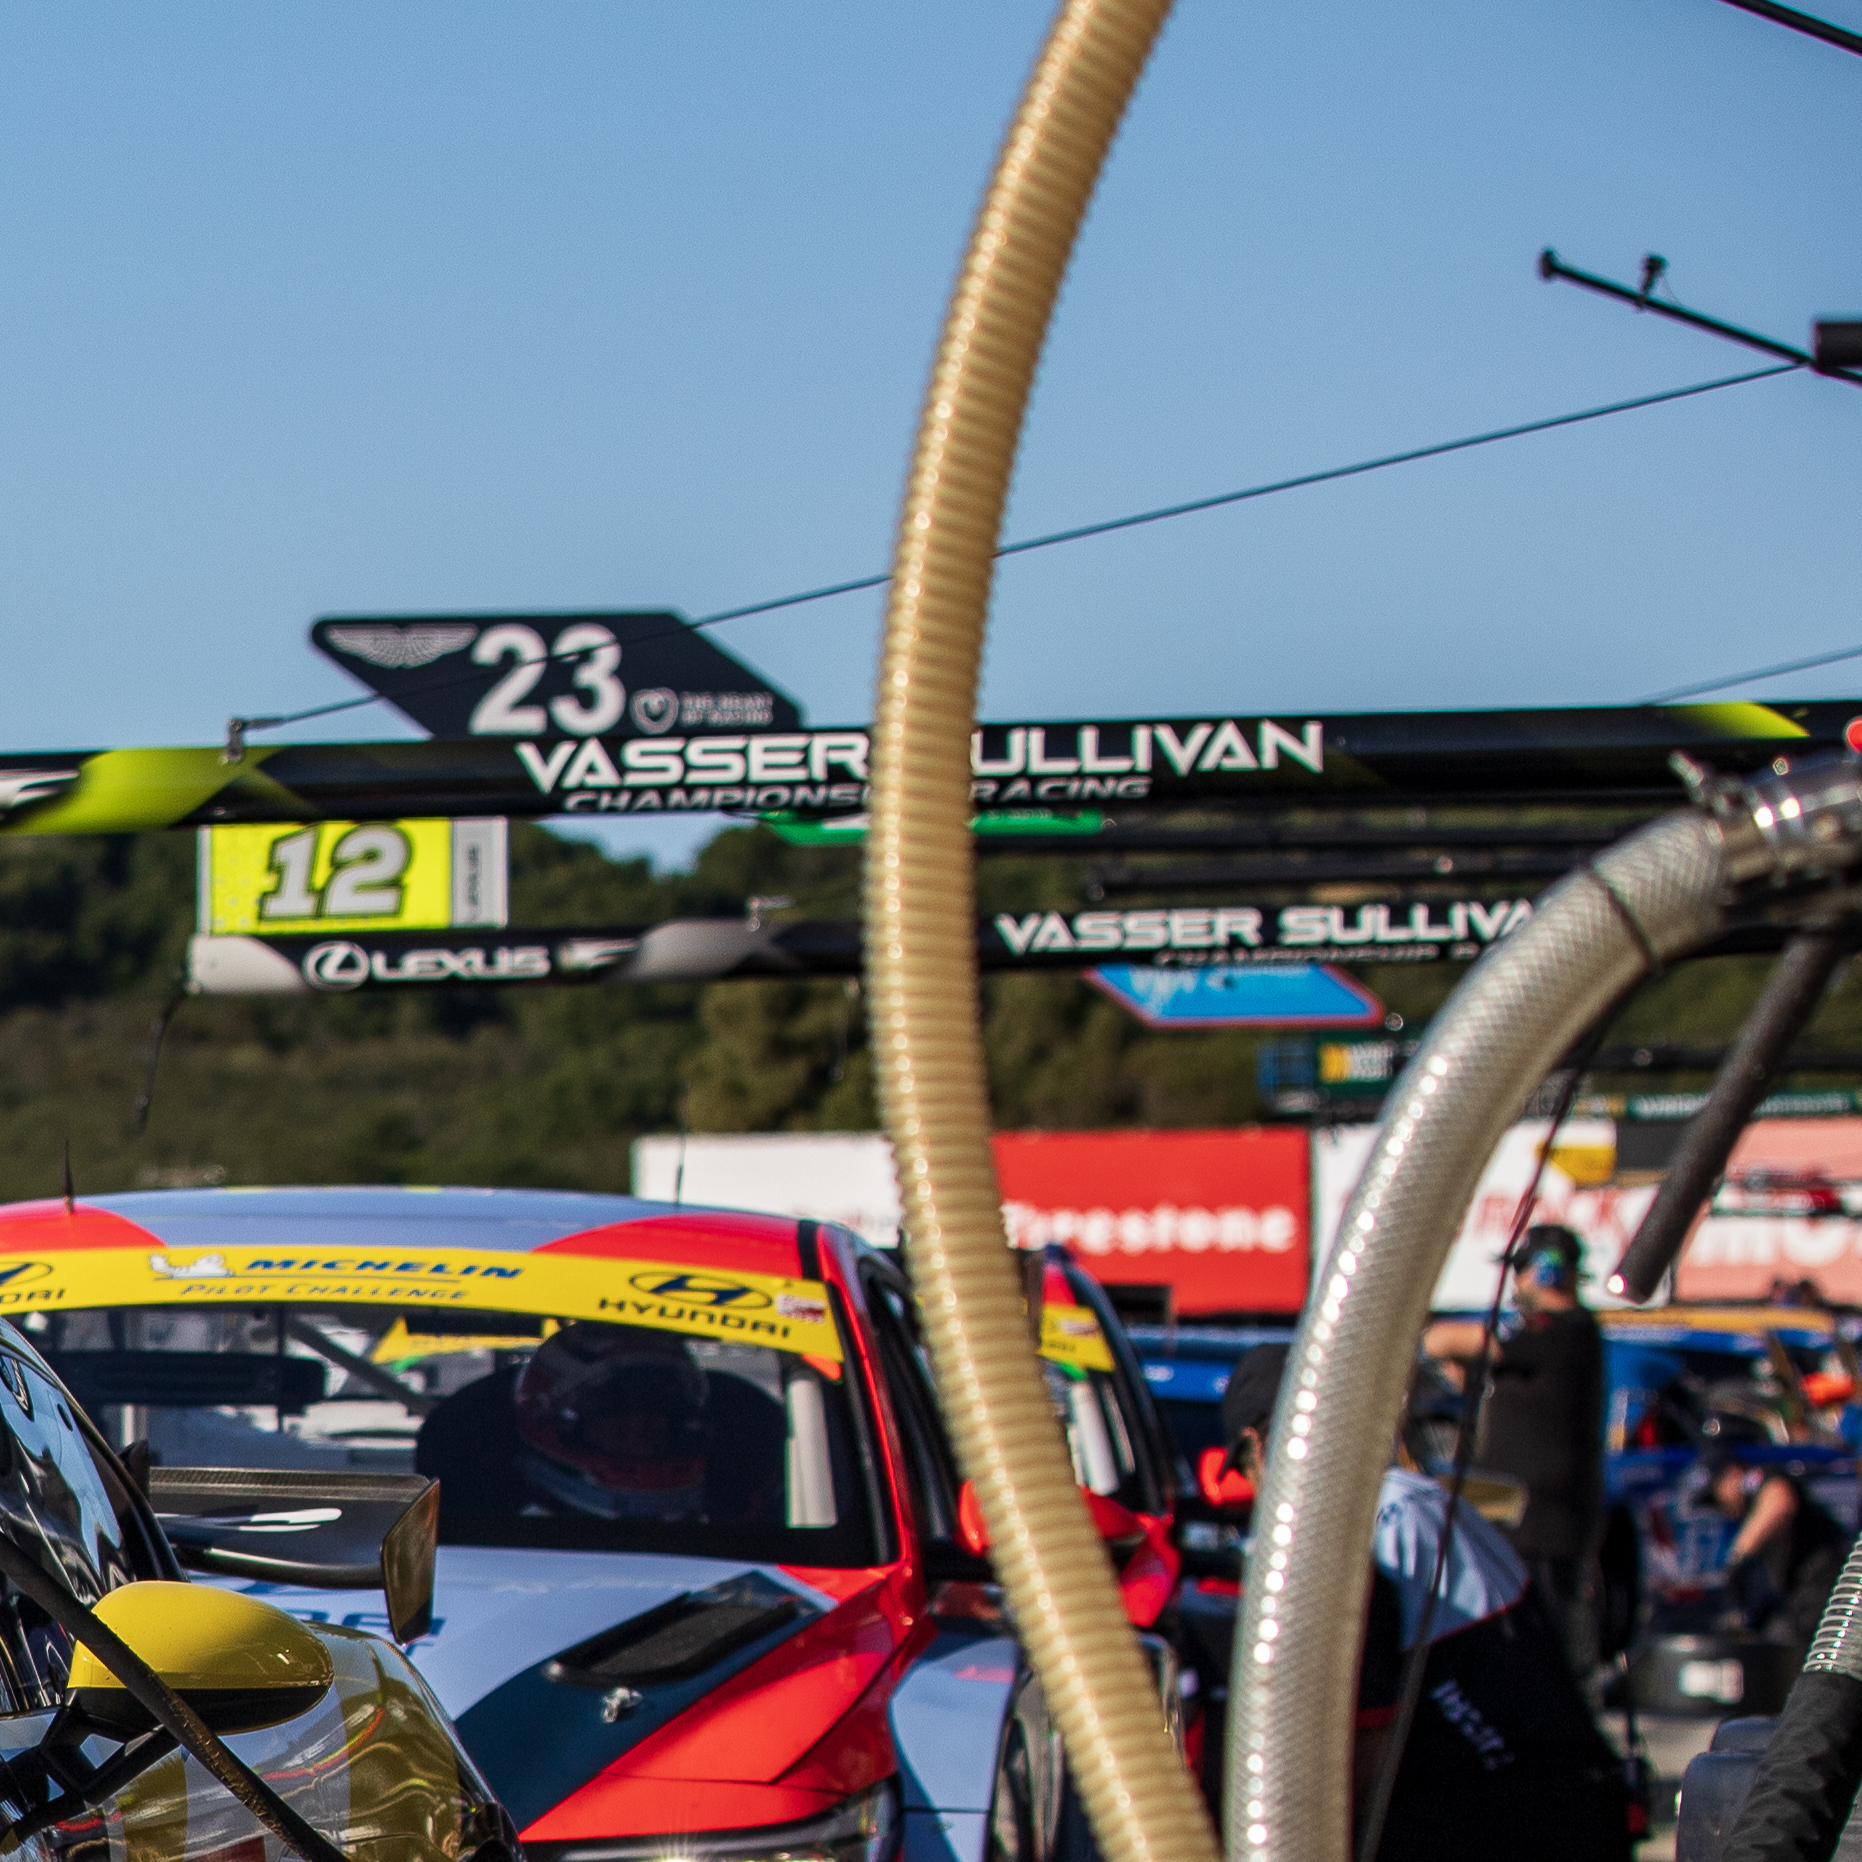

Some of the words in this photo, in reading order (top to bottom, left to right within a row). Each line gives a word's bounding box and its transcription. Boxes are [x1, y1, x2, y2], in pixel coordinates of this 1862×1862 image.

[468, 622, 626, 736] 23
[515, 732, 871, 795] VASSER
[971, 718, 1323, 777] ULLIVAN
[563, 784, 871, 812] CHAMPIONS
[259, 822, 413, 921] 12
[994, 907, 1264, 956] VASSER
[1278, 899, 1537, 948] SULLIVA
[371, 945, 551, 981] LEXUS
[246, 1258, 524, 1279] MICHELIN
[180, 1284, 275, 1296] PILOT
[285, 1283, 470, 1300] CHALLENGE
[599, 1297, 790, 1338] HYUNDAI
